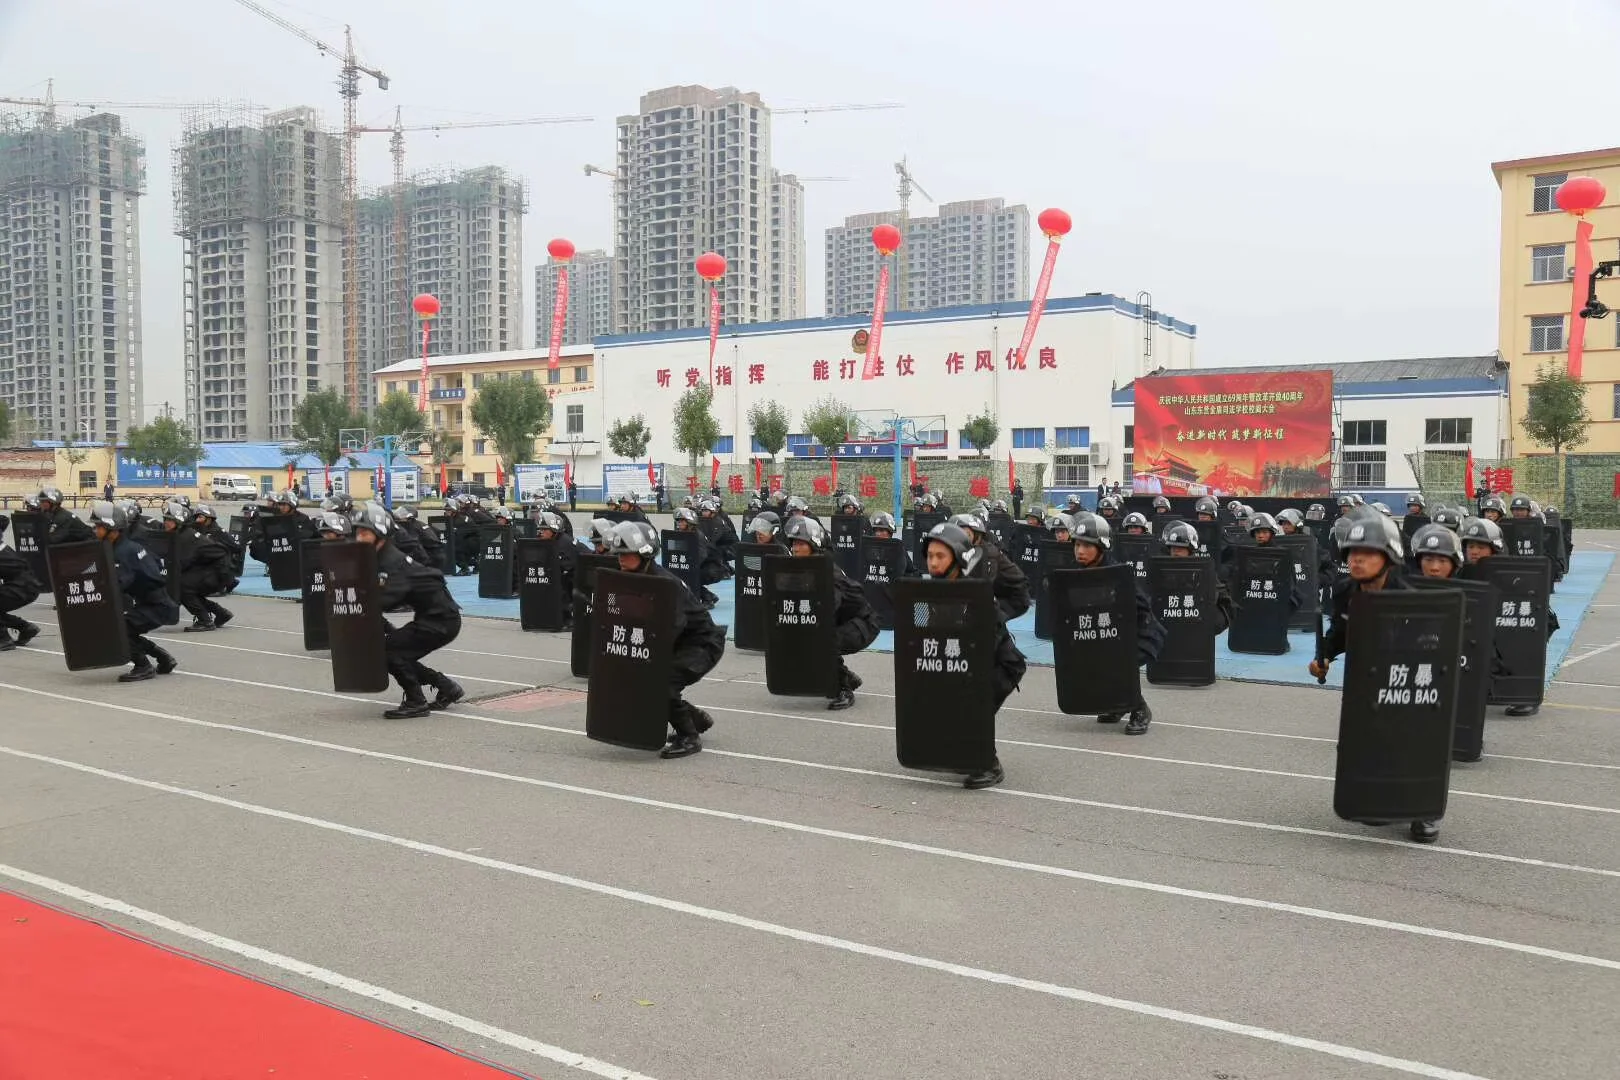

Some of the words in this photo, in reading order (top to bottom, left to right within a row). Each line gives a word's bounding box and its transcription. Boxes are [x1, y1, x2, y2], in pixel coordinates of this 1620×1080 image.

[657, 364, 764, 388] 听党指挥
[946, 347, 1057, 375] 作风优良
[1176, 428, 1226, 442] 奋进新时代
[671, 555, 686, 563] 防暴
[528, 567, 545, 576] 防暴
[870, 565, 886, 575] 防暴
[315, 573, 323, 584] 防
[1251, 580, 1273, 590] 防暴
[69, 580, 95, 595] 防暴
[67, 595, 85, 604] FANG
[87, 593, 102, 602] BAO
[335, 588, 357, 603] 防暴
[1169, 595, 1194, 608] 防暴
[1246, 591, 1262, 599] FANG
[334, 604, 348, 614] FANG
[349, 603, 362, 614] BAO
[783, 600, 811, 614] 防暴
[1163, 609, 1182, 617] FANG
[1185, 609, 1199, 617] BAO
[1502, 602, 1531, 616] 防暴
[779, 615, 798, 624] FANG
[800, 615, 816, 624] BAO
[1079, 613, 1111, 629] 防暴
[1496, 617, 1517, 626] FANG
[1519, 617, 1535, 627] BAO
[613, 625, 645, 645] 防暴
[1074, 631, 1096, 640] FANG
[1100, 628, 1118, 638] BAO
[607, 642, 627, 656] FANG
[631, 646, 649, 659] BAO
[923, 639, 961, 657] 防暴
[917, 659, 942, 671] FANG
[947, 660, 968, 672] BAO
[1390, 664, 1433, 687] 防暴
[1378, 689, 1411, 704] FANG
[1414, 689, 1438, 704] BAO
